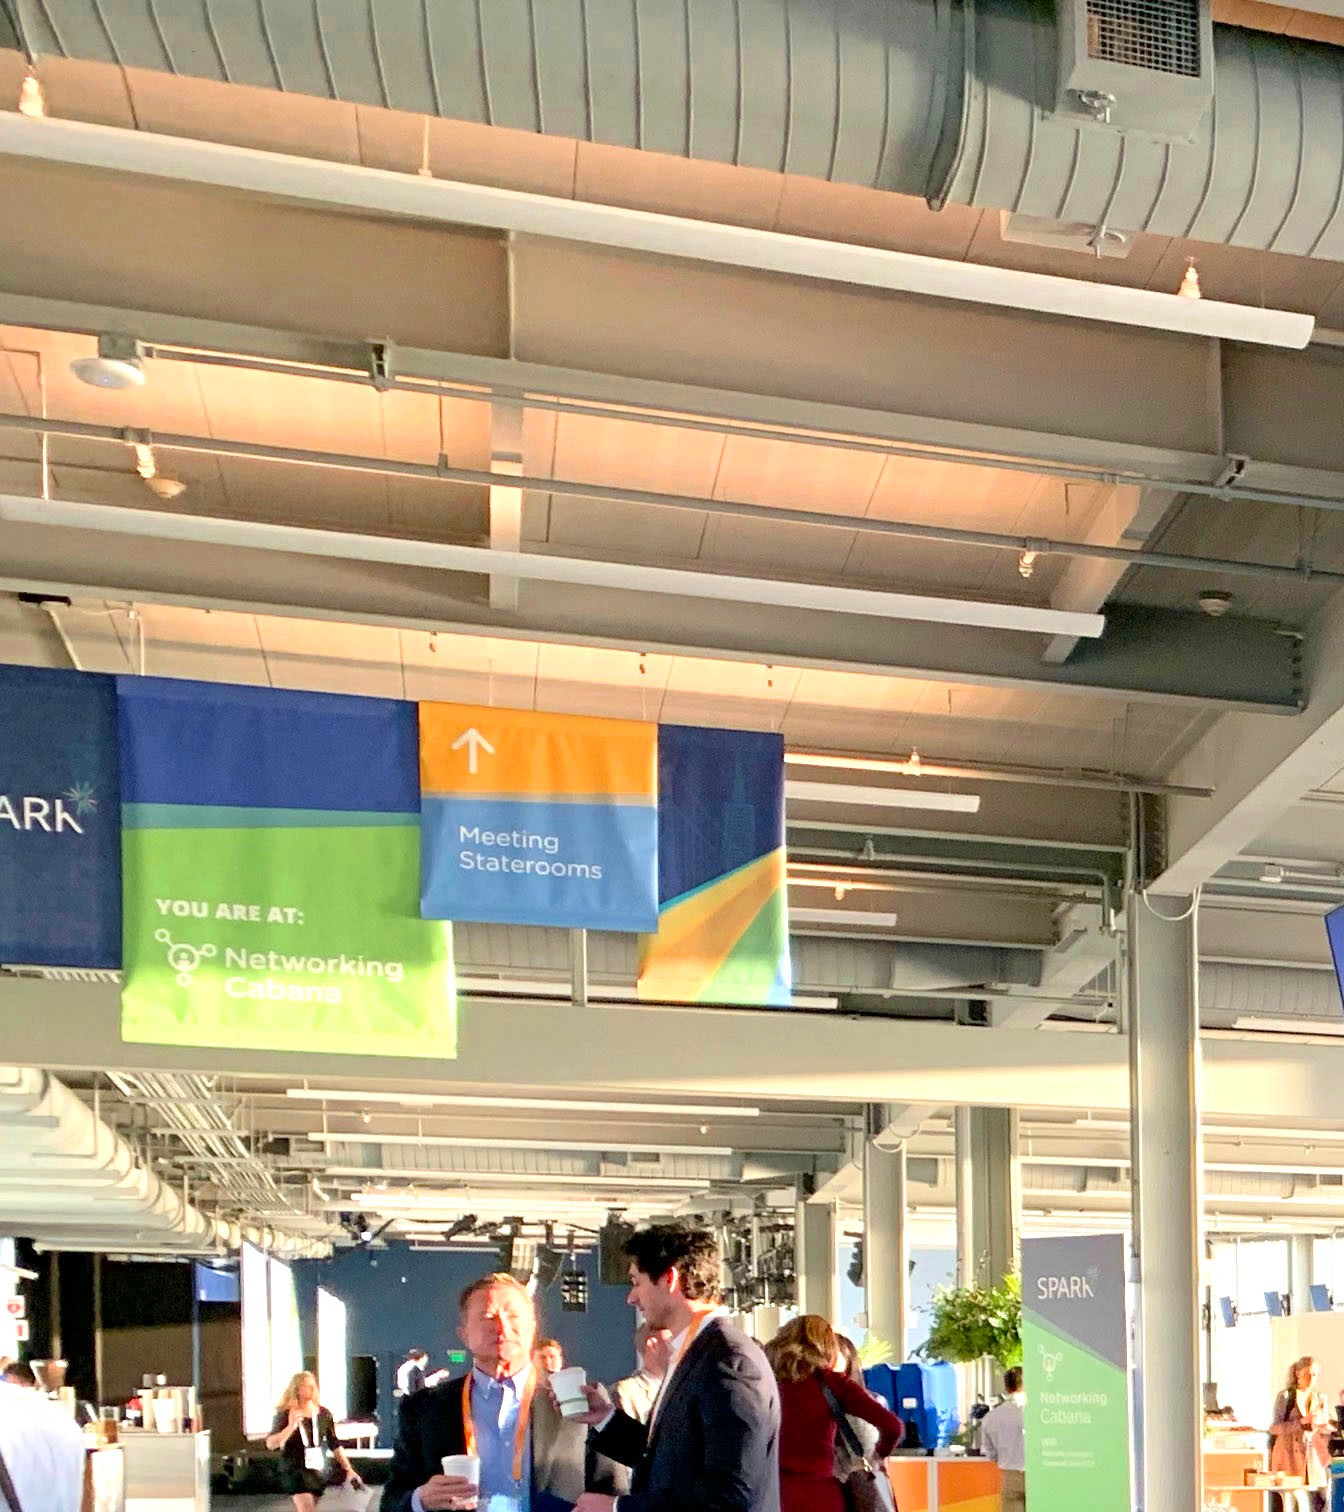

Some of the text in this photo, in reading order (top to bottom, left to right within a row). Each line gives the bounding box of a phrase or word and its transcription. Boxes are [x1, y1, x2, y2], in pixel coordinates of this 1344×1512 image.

[459, 825, 559, 854] Meeting
[459, 851, 603, 879] Staterooms
[155, 898, 304, 925] YOU ARE AT:
[224, 947, 404, 983] Networking
[224, 976, 342, 1004] Cabana
[1037, 1276, 1094, 1299] SPARK
[1040, 1391, 1108, 1406] Networking
[1040, 1408, 1091, 1424] Cabana
